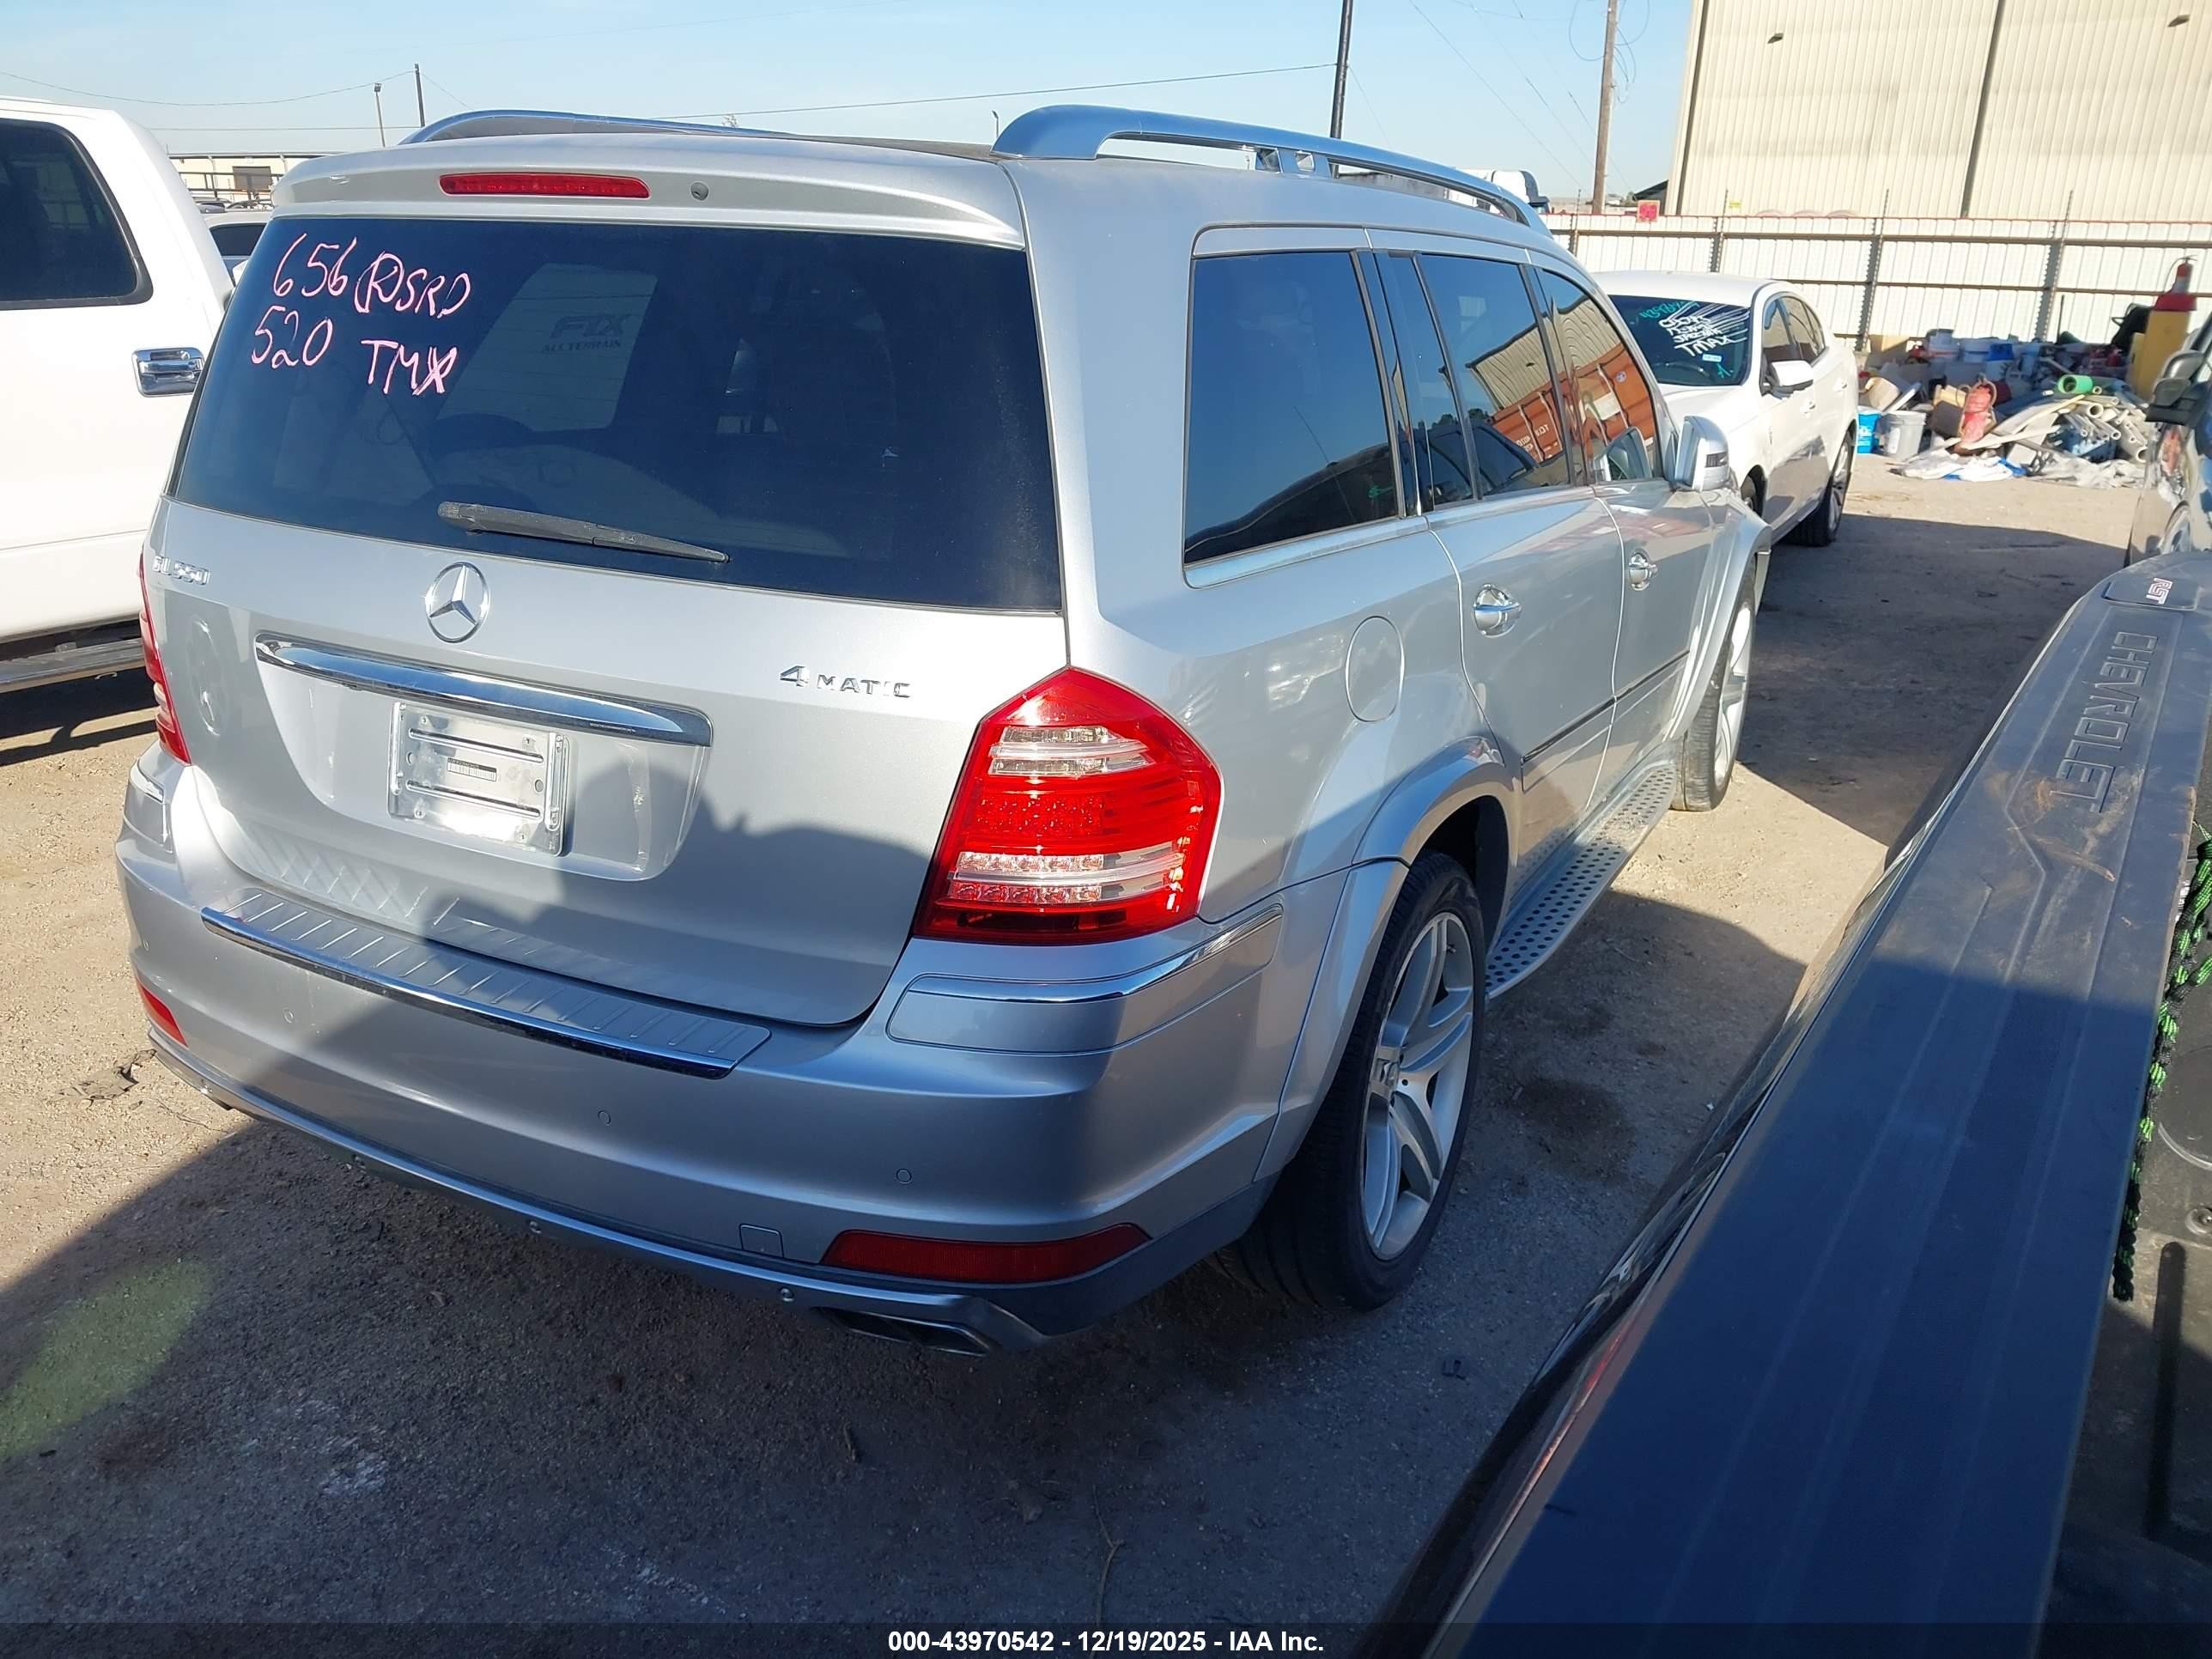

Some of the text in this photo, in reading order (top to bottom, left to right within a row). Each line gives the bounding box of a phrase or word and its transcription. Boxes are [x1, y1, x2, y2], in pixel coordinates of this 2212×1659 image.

[273, 233, 357, 297] 656
[251, 305, 333, 368] 520
[2146, 577, 2173, 605] RST
[2049, 631, 2159, 813] CHEVROLET
